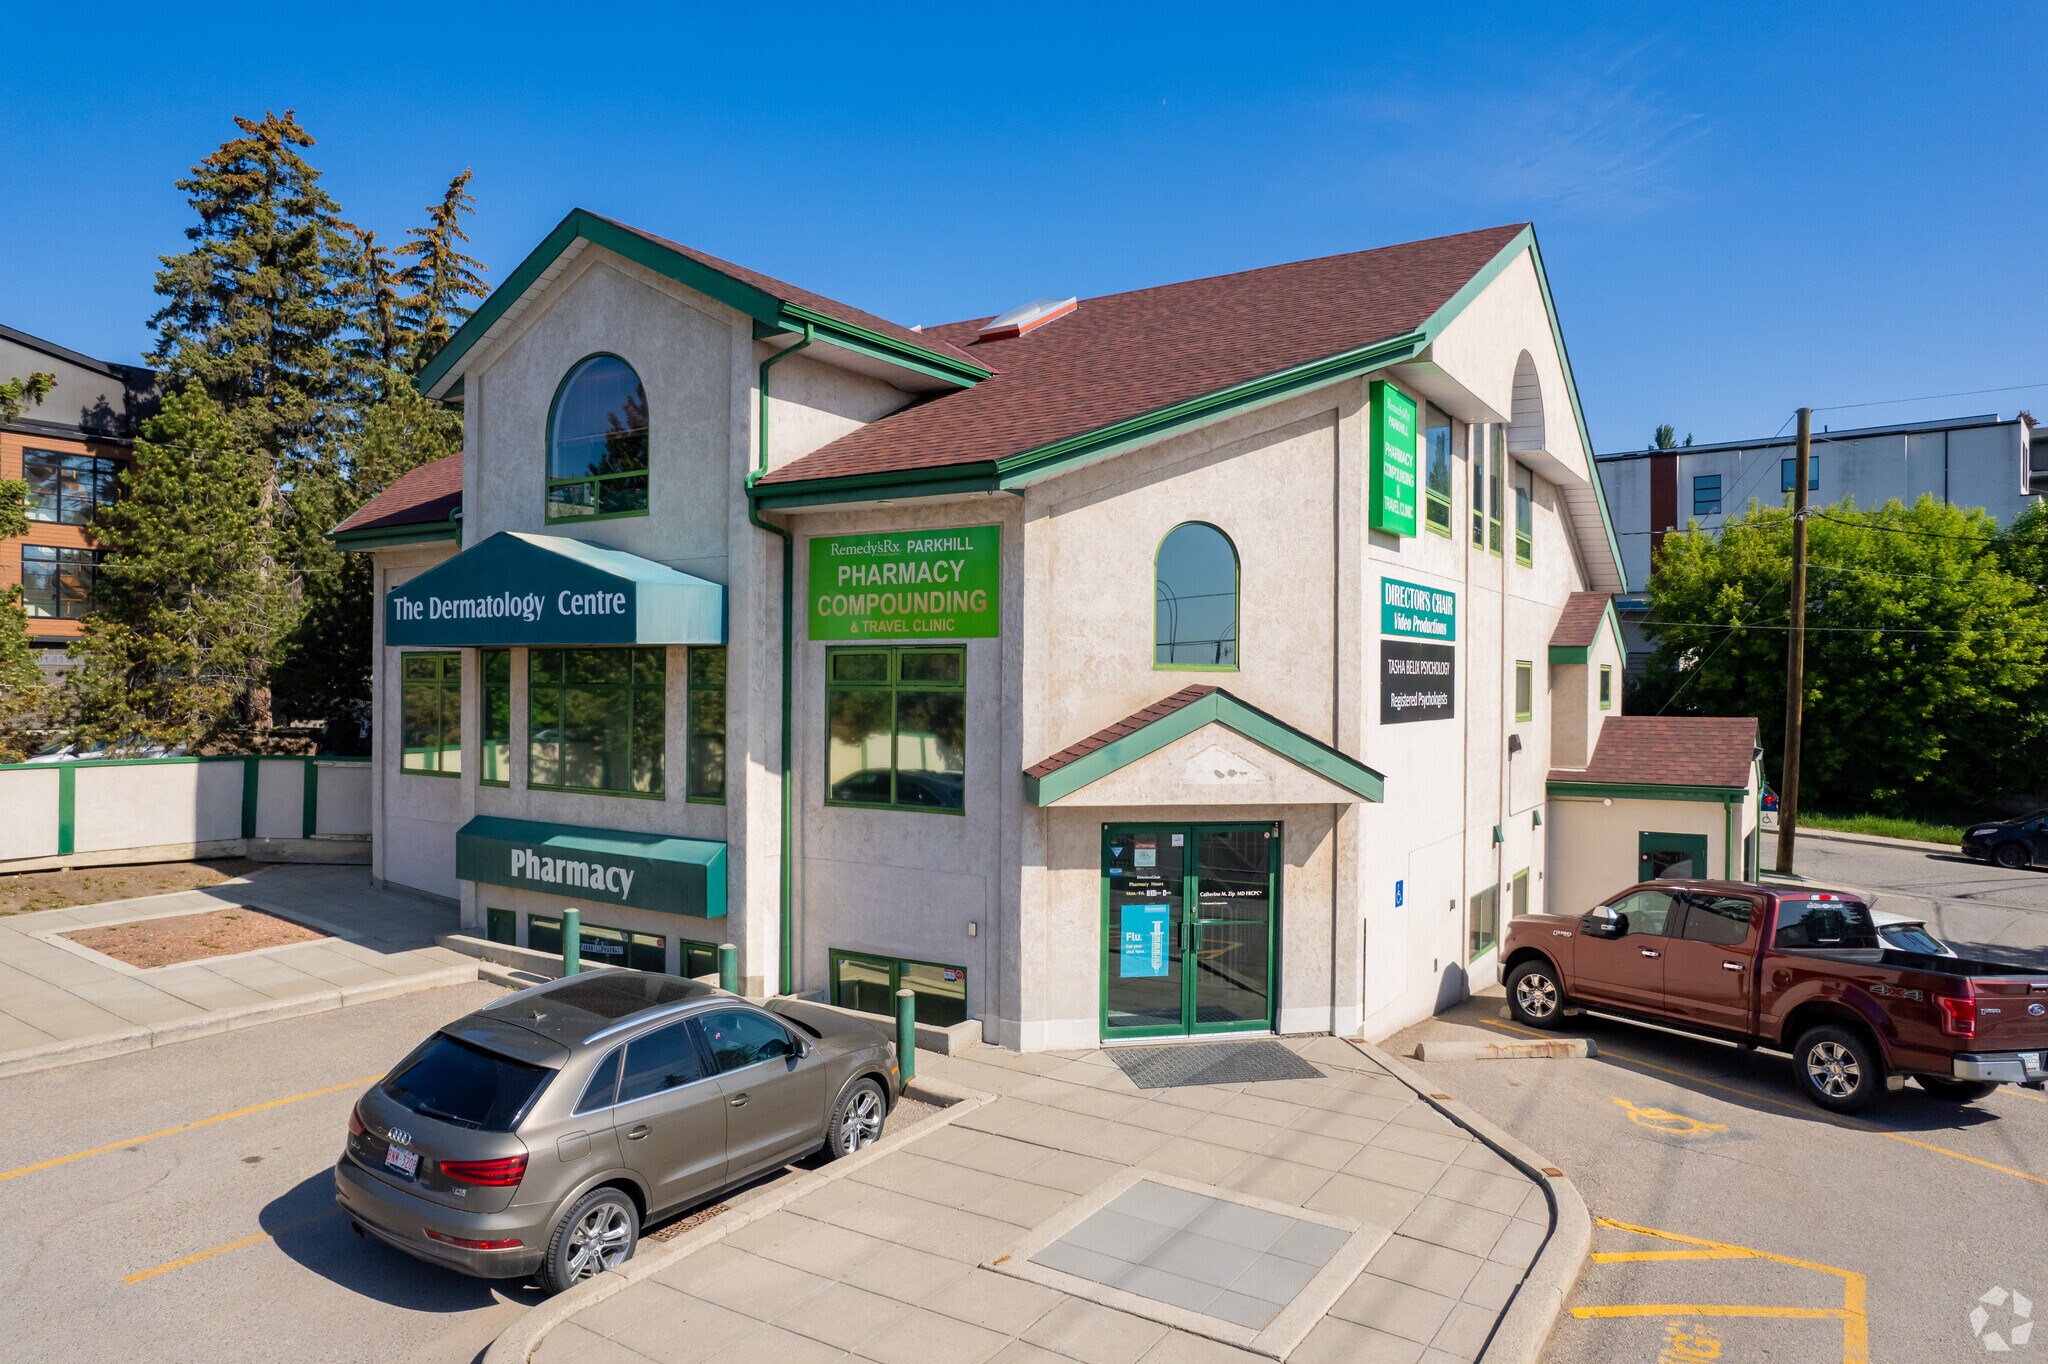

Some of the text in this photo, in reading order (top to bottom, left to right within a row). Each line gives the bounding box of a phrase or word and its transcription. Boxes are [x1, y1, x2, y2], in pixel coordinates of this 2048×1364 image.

[1387, 414, 1409, 437] PARKHILL
[1384, 441, 1414, 468] PHARMACY
[1383, 462, 1415, 488] COMPOUNDING
[1396, 484, 1401, 499] &
[1383, 496, 1414, 520] TRAVEL CLINIC
[907, 536, 974, 554] PARKHILL
[838, 559, 965, 587] PHARMACY
[393, 590, 626, 622] The Dermatology Centre
[817, 589, 988, 617] COMPOUNDING
[1385, 582, 1454, 616] DIRECTOR'S CHAIR
[850, 618, 955, 633] & TRAVEL CLINIC
[1394, 612, 1447, 636] Video Productions
[1388, 659, 1450, 675] TASHA BELIX PSYCHOLOGY
[1390, 691, 1448, 711] Registered Psychologists
[511, 848, 635, 900] Pharmacy
[1126, 931, 1143, 942] Flu.
